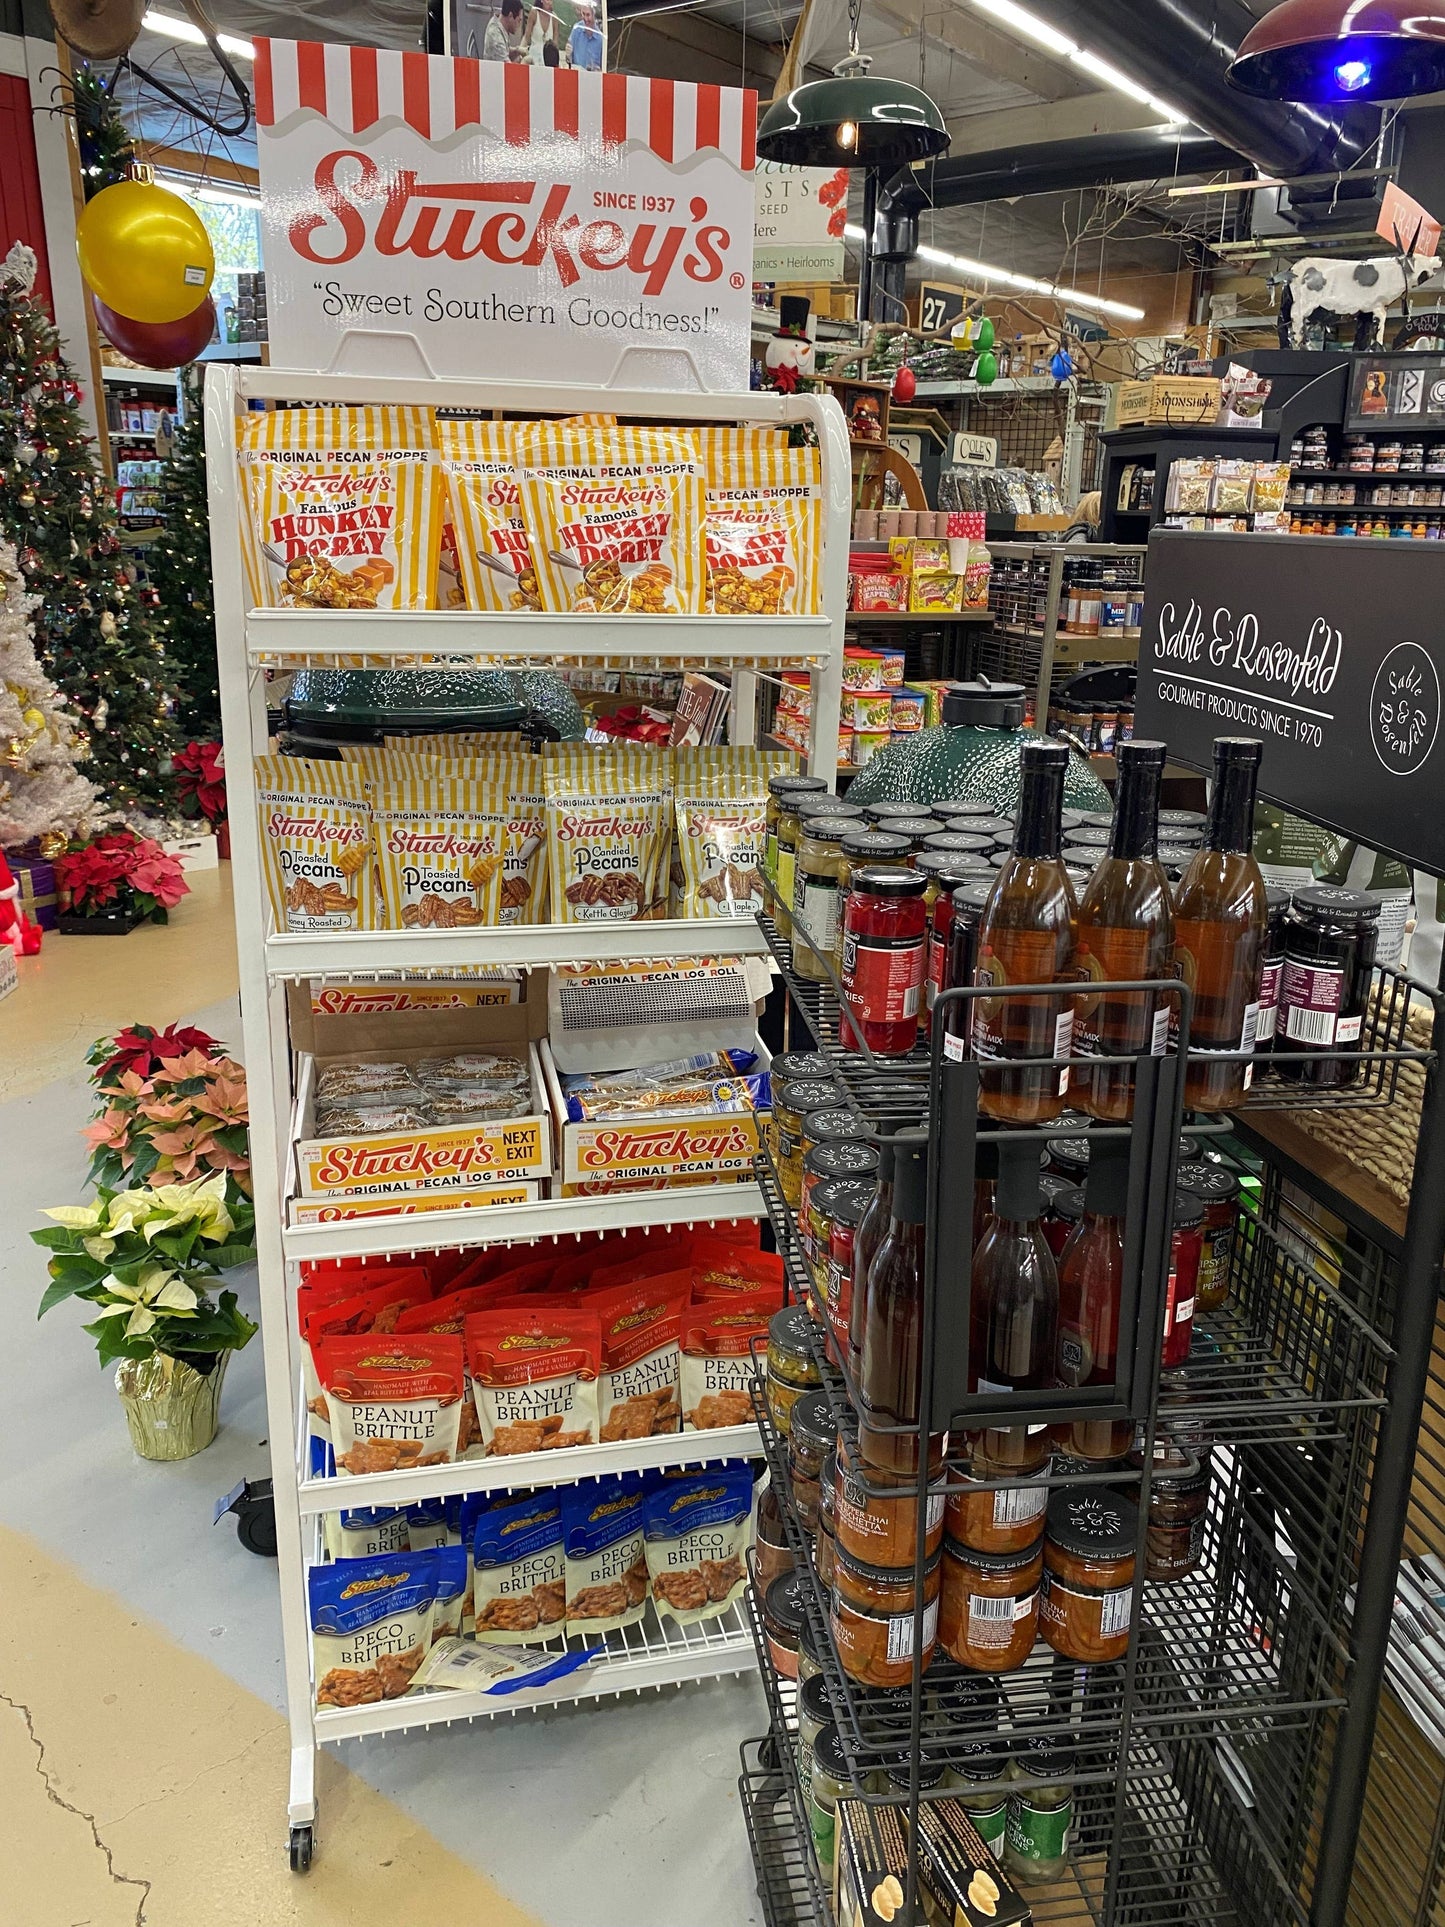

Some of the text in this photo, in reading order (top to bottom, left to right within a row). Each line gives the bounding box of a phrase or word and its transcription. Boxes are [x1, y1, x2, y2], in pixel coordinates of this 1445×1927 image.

[592, 190, 676, 213] SINCE 1937
[288, 149, 731, 296] Stuckey's
[787, 257, 834, 268] Heirlooms
[423, 288, 556, 325] Southern
[924, 297, 947, 330] 27
[1157, 396, 1215, 408] MOONSHINE
[260, 452, 321, 462] ORIGINAL
[327, 452, 371, 462] PECAN
[377, 452, 429, 462] SHOPPE
[960, 438, 992, 463] COLE'S
[465, 463, 515, 474] ORIGINA
[537, 468, 596, 479] ORIGINAL
[600, 467, 641, 477] PECAN
[646, 465, 695, 476] SHOPPE
[278, 469, 393, 497] Stuckey's
[560, 484, 667, 505] Stuckey's
[719, 489, 758, 500] PECAN
[763, 487, 810, 498] SHOPPE
[270, 506, 394, 543] HUNKEY
[584, 508, 638, 525] Famous
[558, 513, 672, 549] HUNKEY
[285, 532, 386, 562] DOREY
[577, 538, 664, 568] DOREY
[1154, 599, 1343, 697] Sable & Rosenfeld
[1388, 664, 1423, 698] Sable
[1158, 682, 1323, 748] GOURMET PRODUCTS SINCE 1970
[1379, 702, 1427, 757] Rosenfeld
[268, 813, 365, 844] Stuckey's
[557, 815, 653, 841] Stuckey's
[387, 829, 496, 858] Stuckey's
[592, 844, 630, 857] Candied
[280, 850, 345, 878] Pecans
[293, 851, 328, 864] Toasted
[573, 847, 639, 875] Pecans
[402, 866, 475, 894] Pecans
[421, 868, 460, 879] Toasted
[582, 974, 636, 986] ORIGINAL
[502, 1130, 536, 1145] NEXT
[584, 1125, 749, 1166] Stuckey's
[318, 1137, 495, 1184] Stuckey's
[506, 1145, 534, 1160] EXIT
[607, 1166, 666, 1179] ORIGINAL
[672, 1160, 714, 1173] PECAN
[344, 1181, 410, 1196] ORIGINAL
[416, 1175, 460, 1188] PECAN
[611, 1350, 680, 1387] PEANUT
[494, 1382, 576, 1405] PEANUT
[613, 1367, 680, 1400] BRITTLE
[351, 1406, 438, 1424] PEANUT
[497, 1397, 574, 1421] BRITTLE
[354, 1422, 435, 1440] BRITTLE
[1068, 1497, 1103, 1512] Sable
[1069, 1510, 1122, 1538] Rosenfeld
[601, 1539, 641, 1566] PECO
[667, 1543, 734, 1565] BRITTLE
[679, 1533, 724, 1549] PECO
[500, 1563, 566, 1594] BRITTLE
[511, 1555, 556, 1578] PECO
[340, 1571, 410, 1599] Stuckey's
[341, 1632, 417, 1664] BRITTLE
[354, 1623, 403, 1650] PECO
